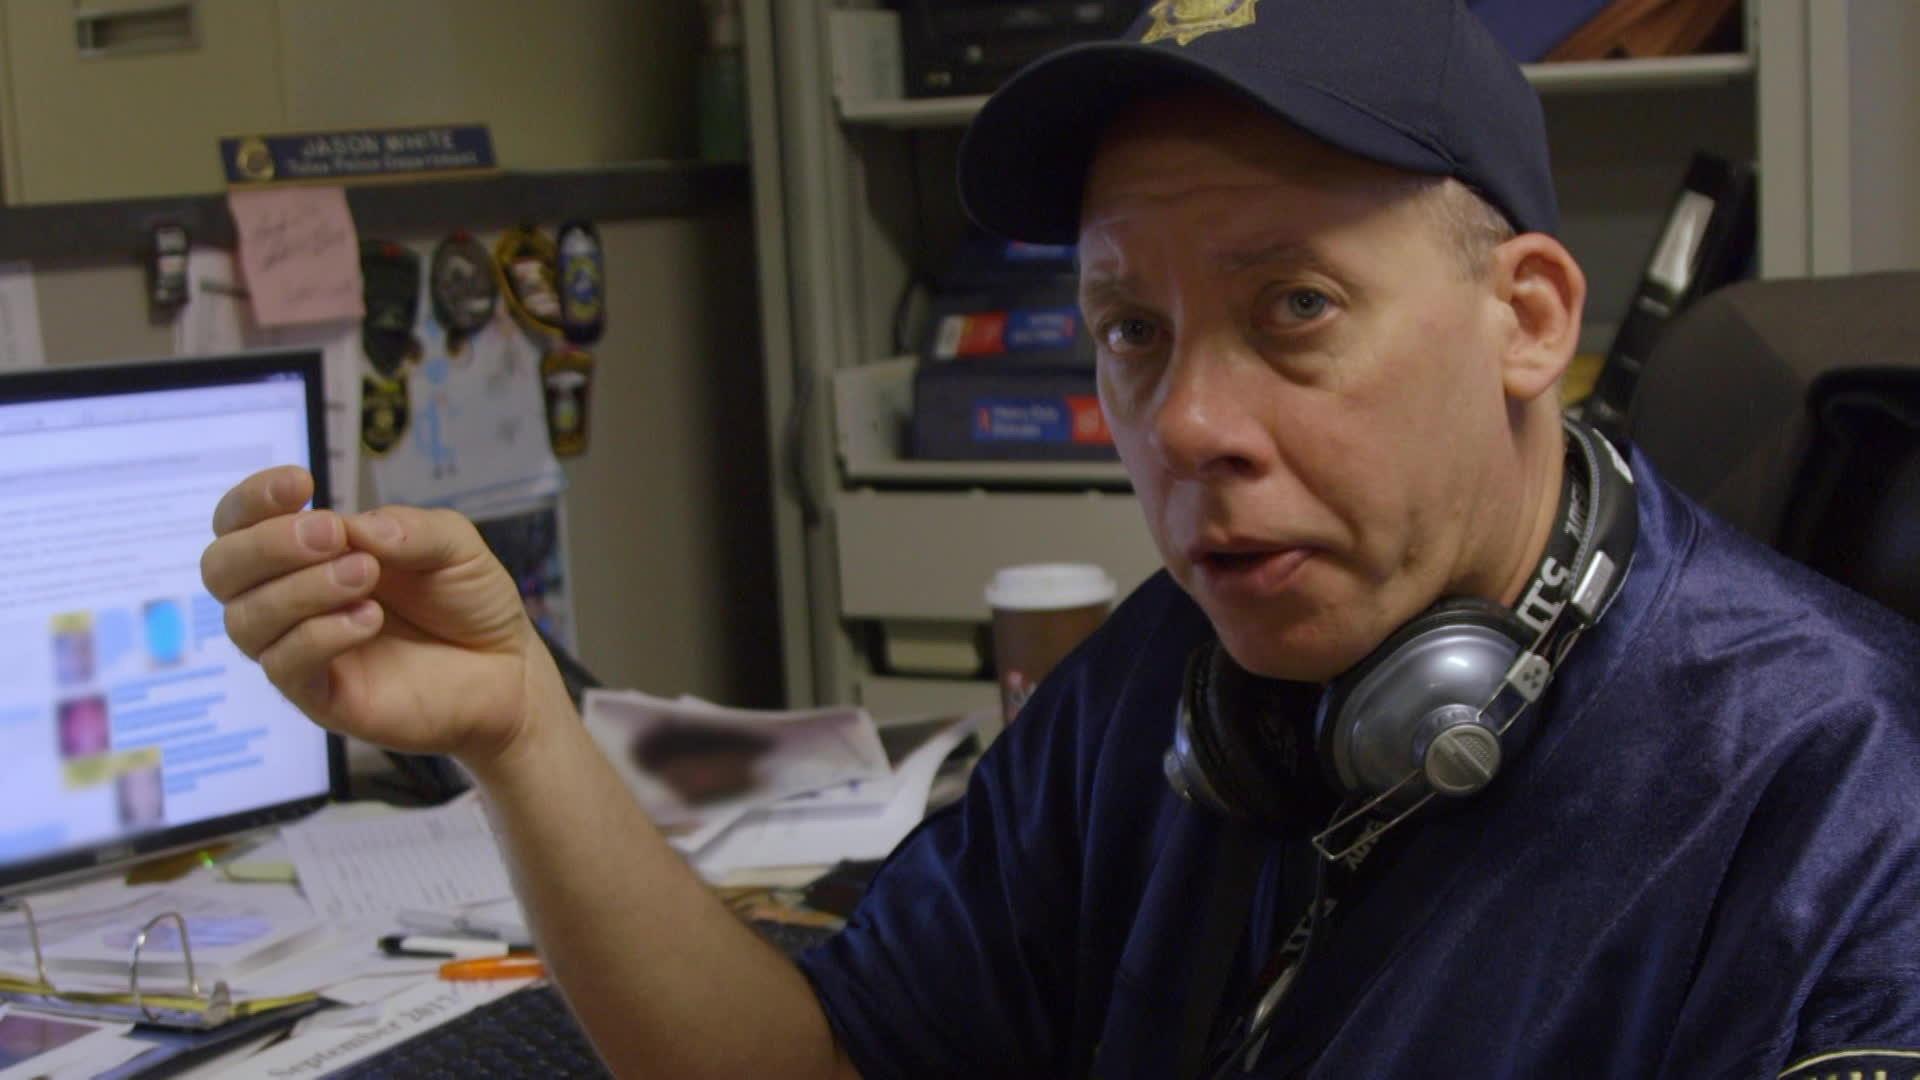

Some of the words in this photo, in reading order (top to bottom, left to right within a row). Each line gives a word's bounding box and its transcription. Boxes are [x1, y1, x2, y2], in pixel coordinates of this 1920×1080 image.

[303, 134, 378, 158] JASON
[384, 128, 455, 152] WHITE
[266, 1017, 403, 1077] September
